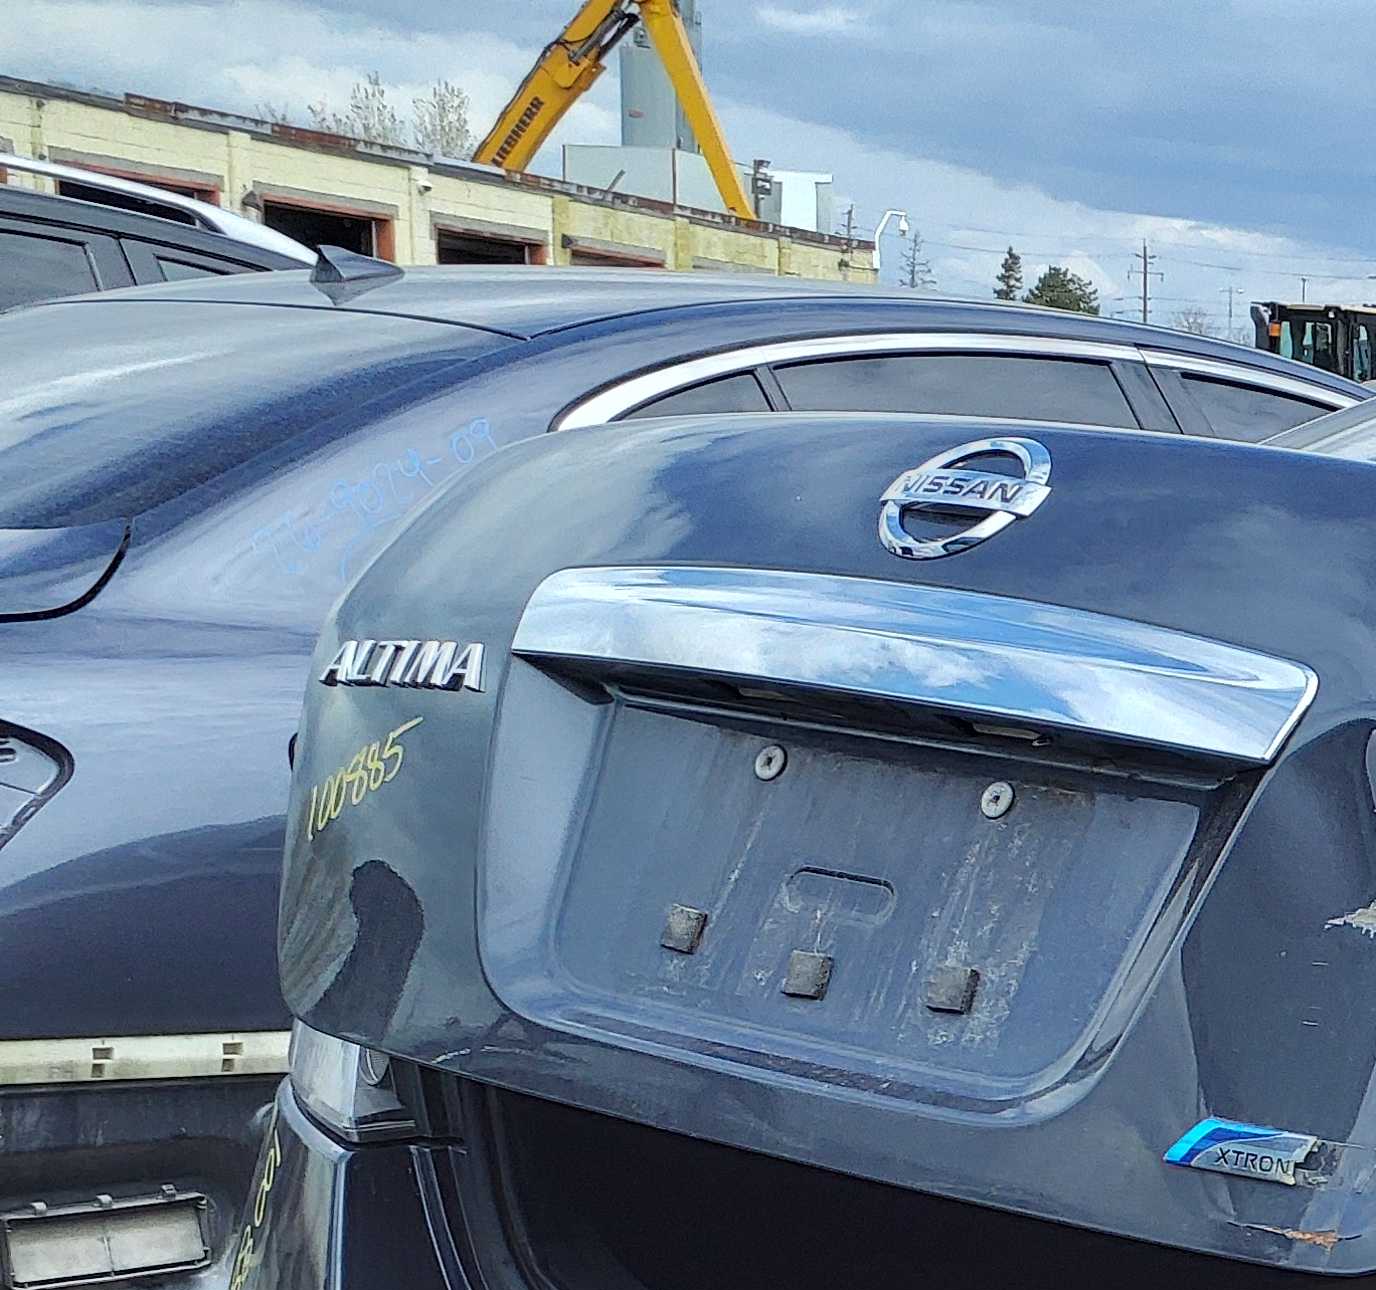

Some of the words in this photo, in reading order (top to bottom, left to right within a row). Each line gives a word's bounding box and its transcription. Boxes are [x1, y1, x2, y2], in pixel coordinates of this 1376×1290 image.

[491, 96, 544, 168] LIEBHERR
[903, 474, 1023, 504] NISSAN
[319, 638, 487, 694] ALTIMA
[307, 715, 425, 842] 100885
